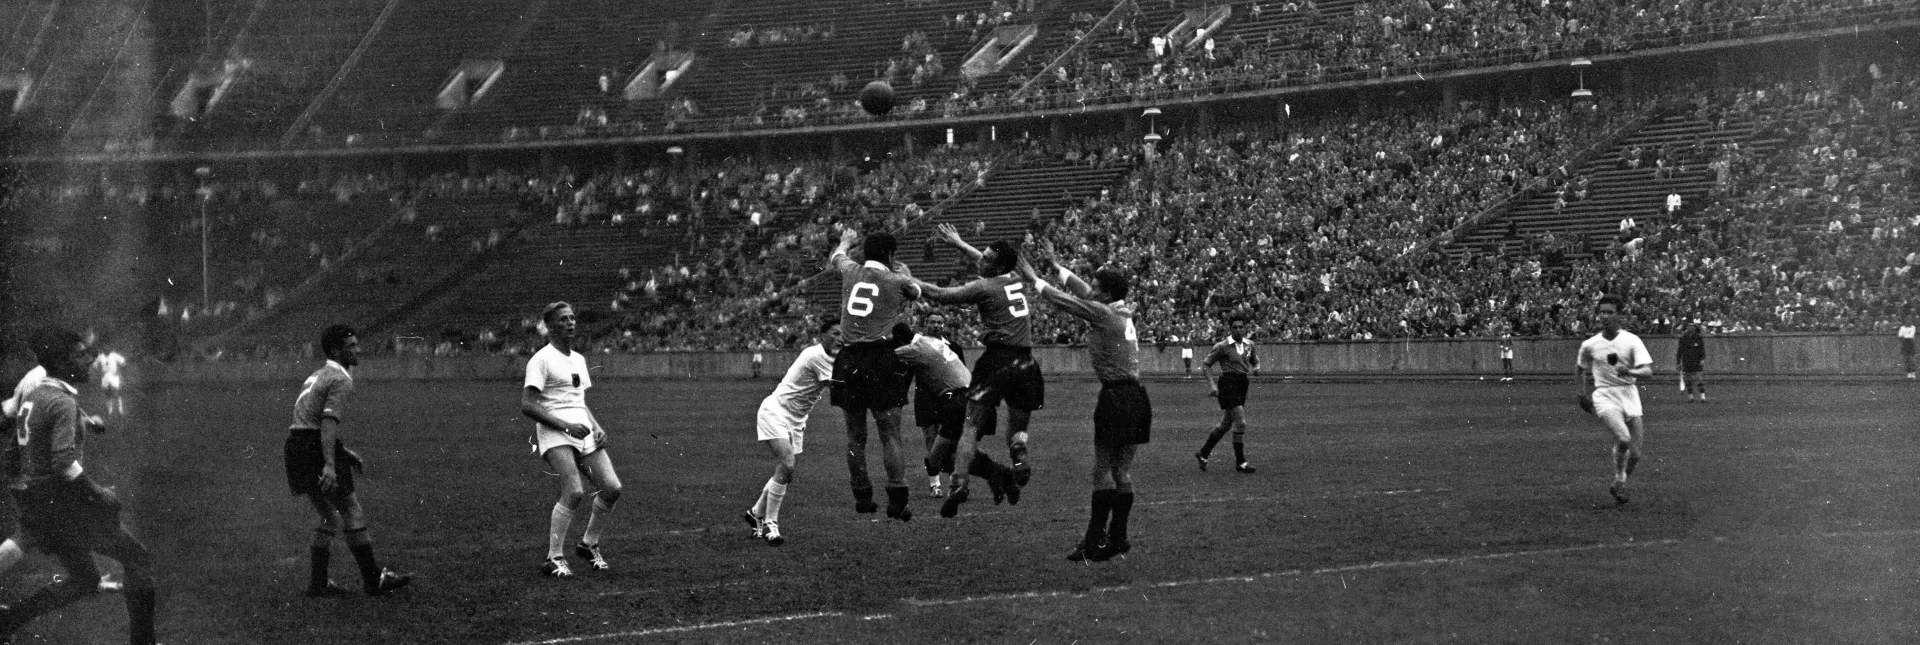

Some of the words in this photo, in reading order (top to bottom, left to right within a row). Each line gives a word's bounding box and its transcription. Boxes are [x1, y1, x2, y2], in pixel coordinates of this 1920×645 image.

[847, 282, 879, 316] 6
[1004, 283, 1029, 317] 5
[1124, 317, 1139, 351] 4
